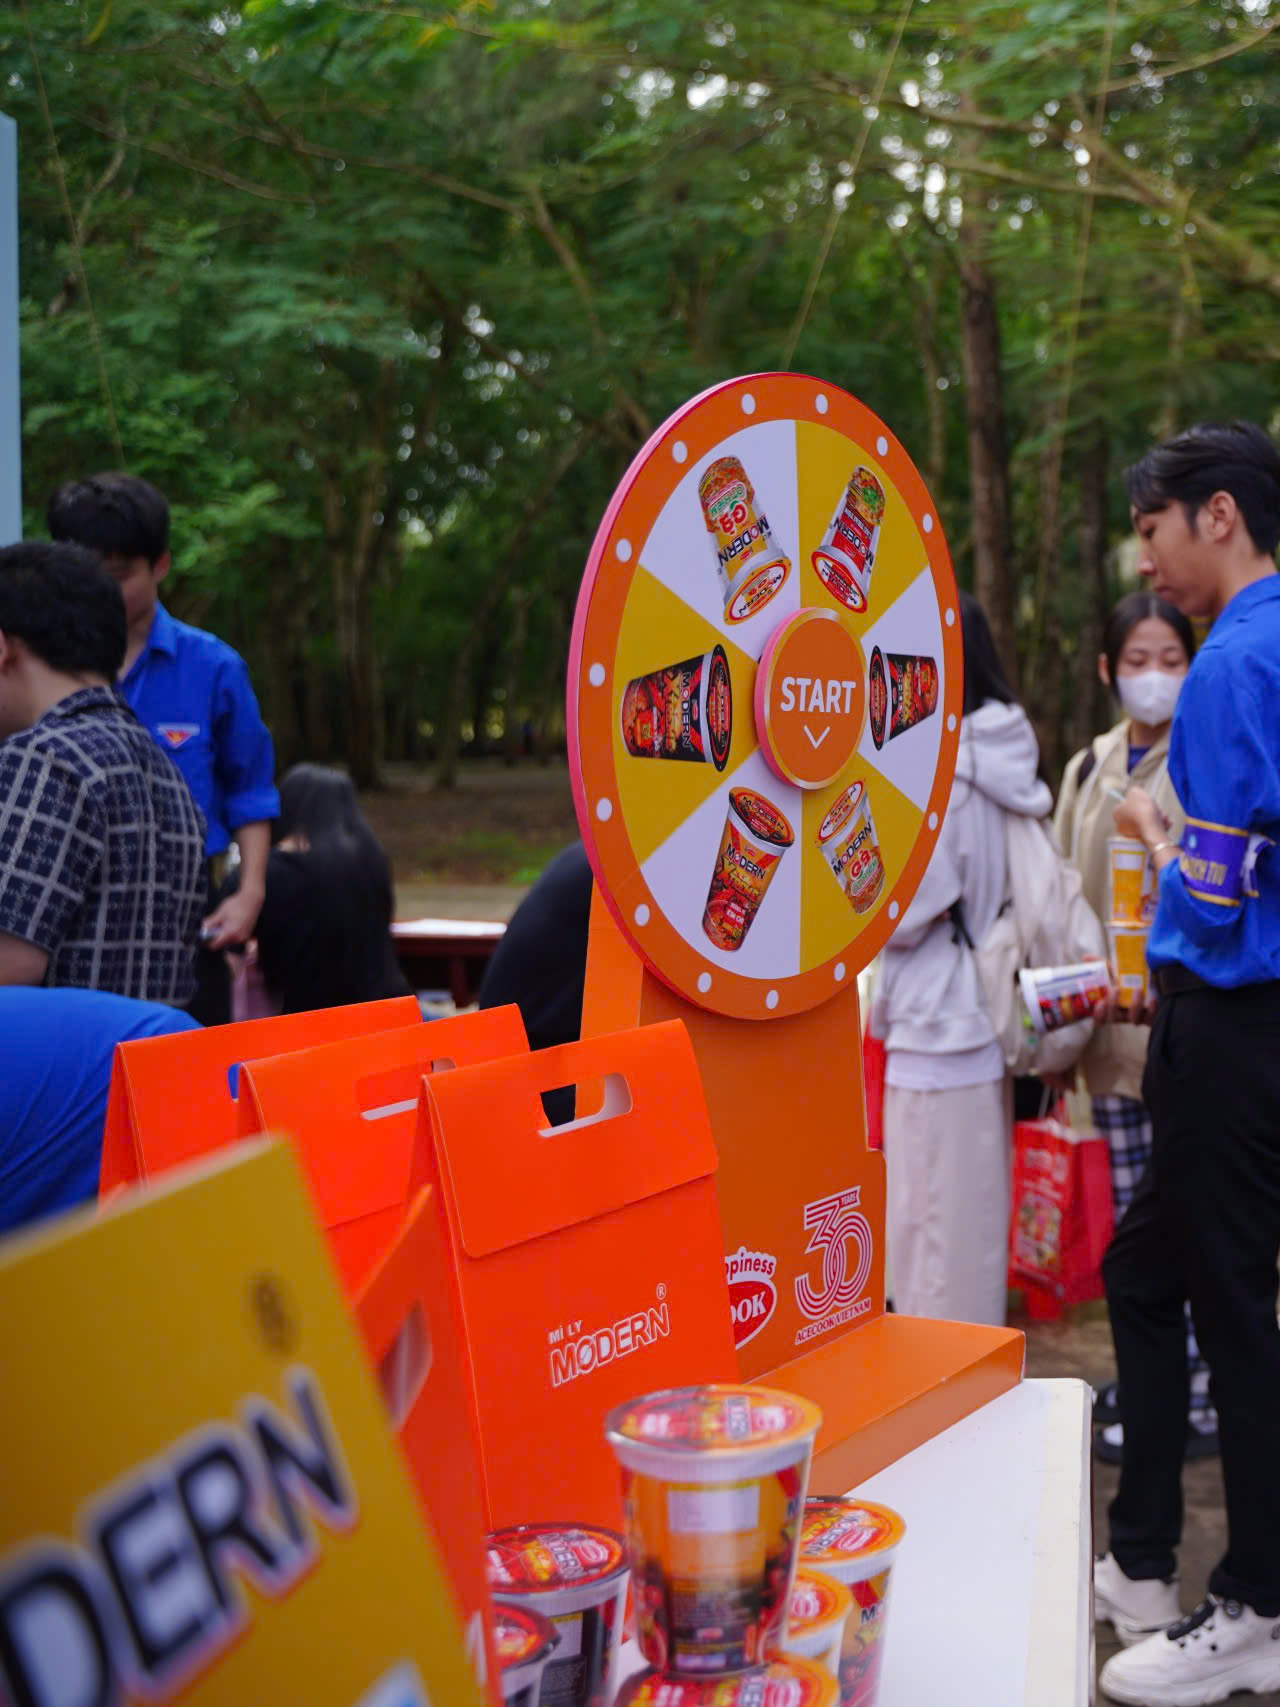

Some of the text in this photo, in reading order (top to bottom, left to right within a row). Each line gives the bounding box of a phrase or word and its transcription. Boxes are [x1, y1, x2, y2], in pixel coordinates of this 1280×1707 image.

[718, 516, 770, 567] MODERN
[833, 516, 874, 567] MODERN
[681, 672, 692, 748] MODERN
[780, 676, 856, 714] START
[727, 843, 767, 880] MODERN
[832, 822, 873, 876] MODERN
[841, 1193, 857, 1206] YEARS
[795, 1186, 873, 1320] 30
[551, 1303, 671, 1388] MODERN
[567, 1320, 583, 1337] LY
[796, 1299, 871, 1343] ACECOOK VIETNAM
